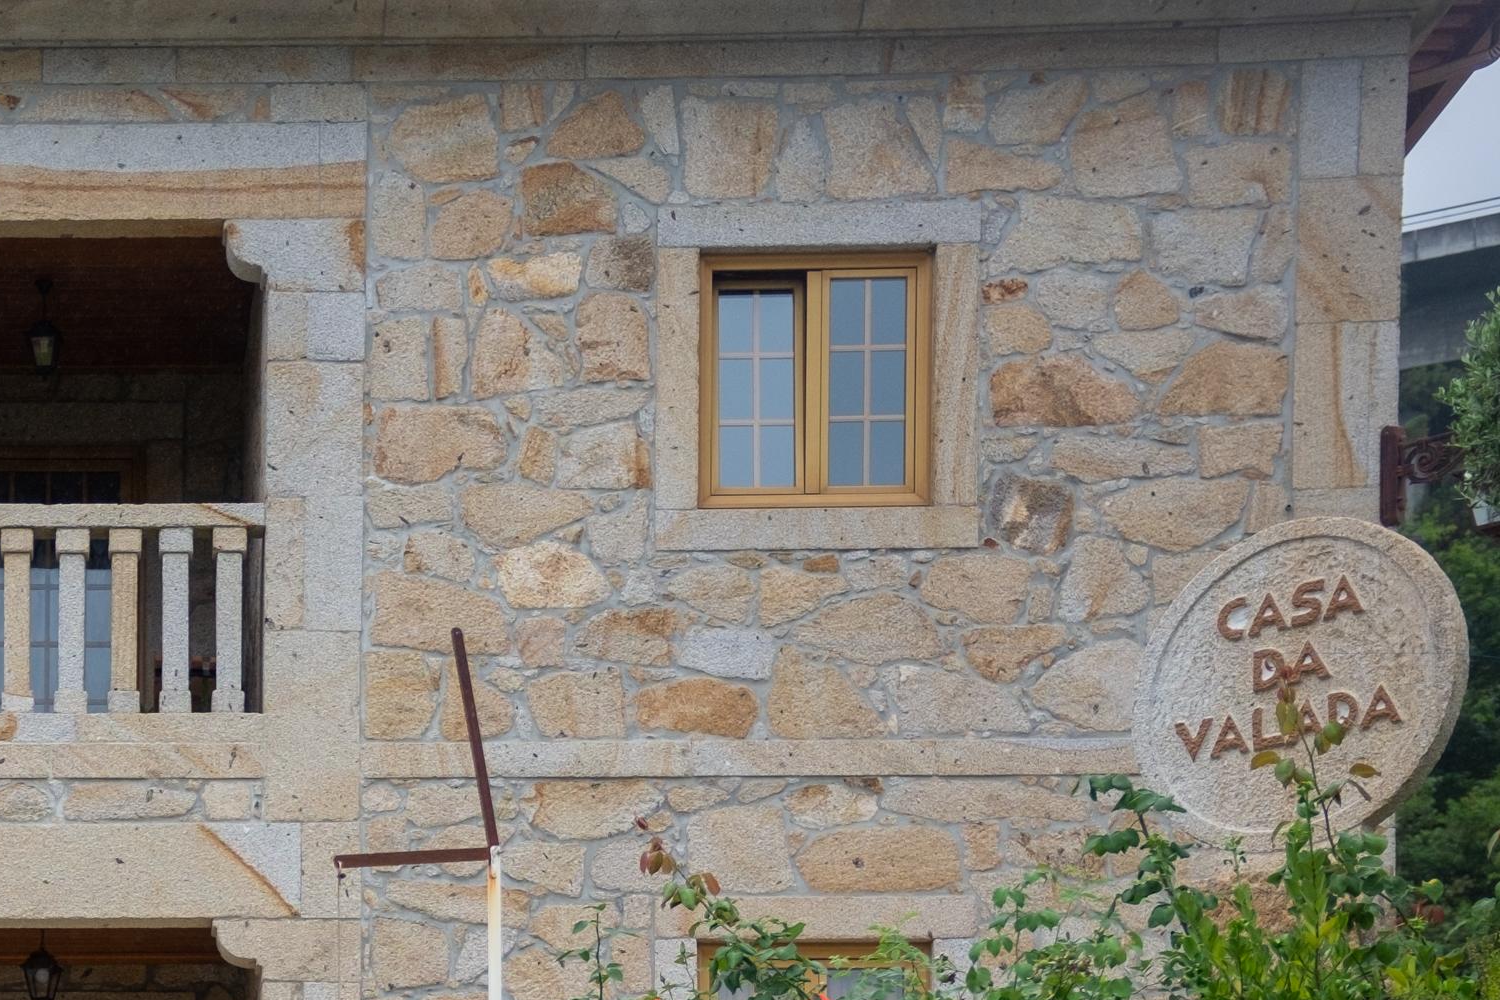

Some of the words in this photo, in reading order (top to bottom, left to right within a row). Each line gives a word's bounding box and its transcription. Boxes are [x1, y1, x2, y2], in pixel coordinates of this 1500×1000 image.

[1217, 574, 1365, 641] CASA
[1252, 640, 1332, 693] DA
[1174, 684, 1403, 762] VALADA
